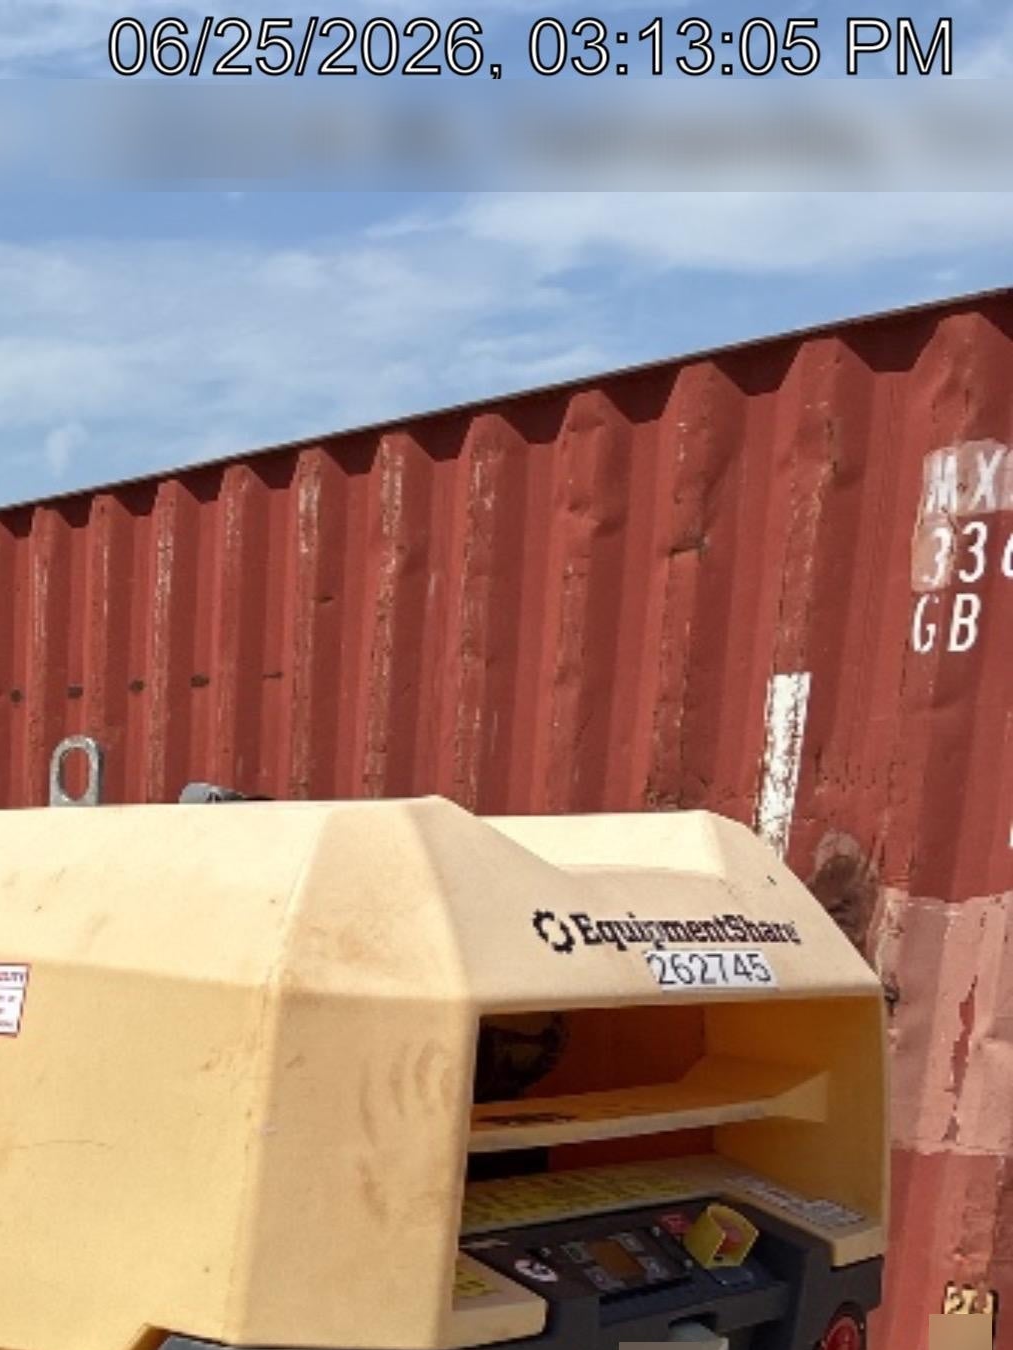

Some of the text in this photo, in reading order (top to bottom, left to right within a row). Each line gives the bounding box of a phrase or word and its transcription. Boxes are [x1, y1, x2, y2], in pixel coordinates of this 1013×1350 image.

[925, 449, 1013, 512] MX
[912, 593, 981, 653] GB
[646, 953, 771, 984] 262745
